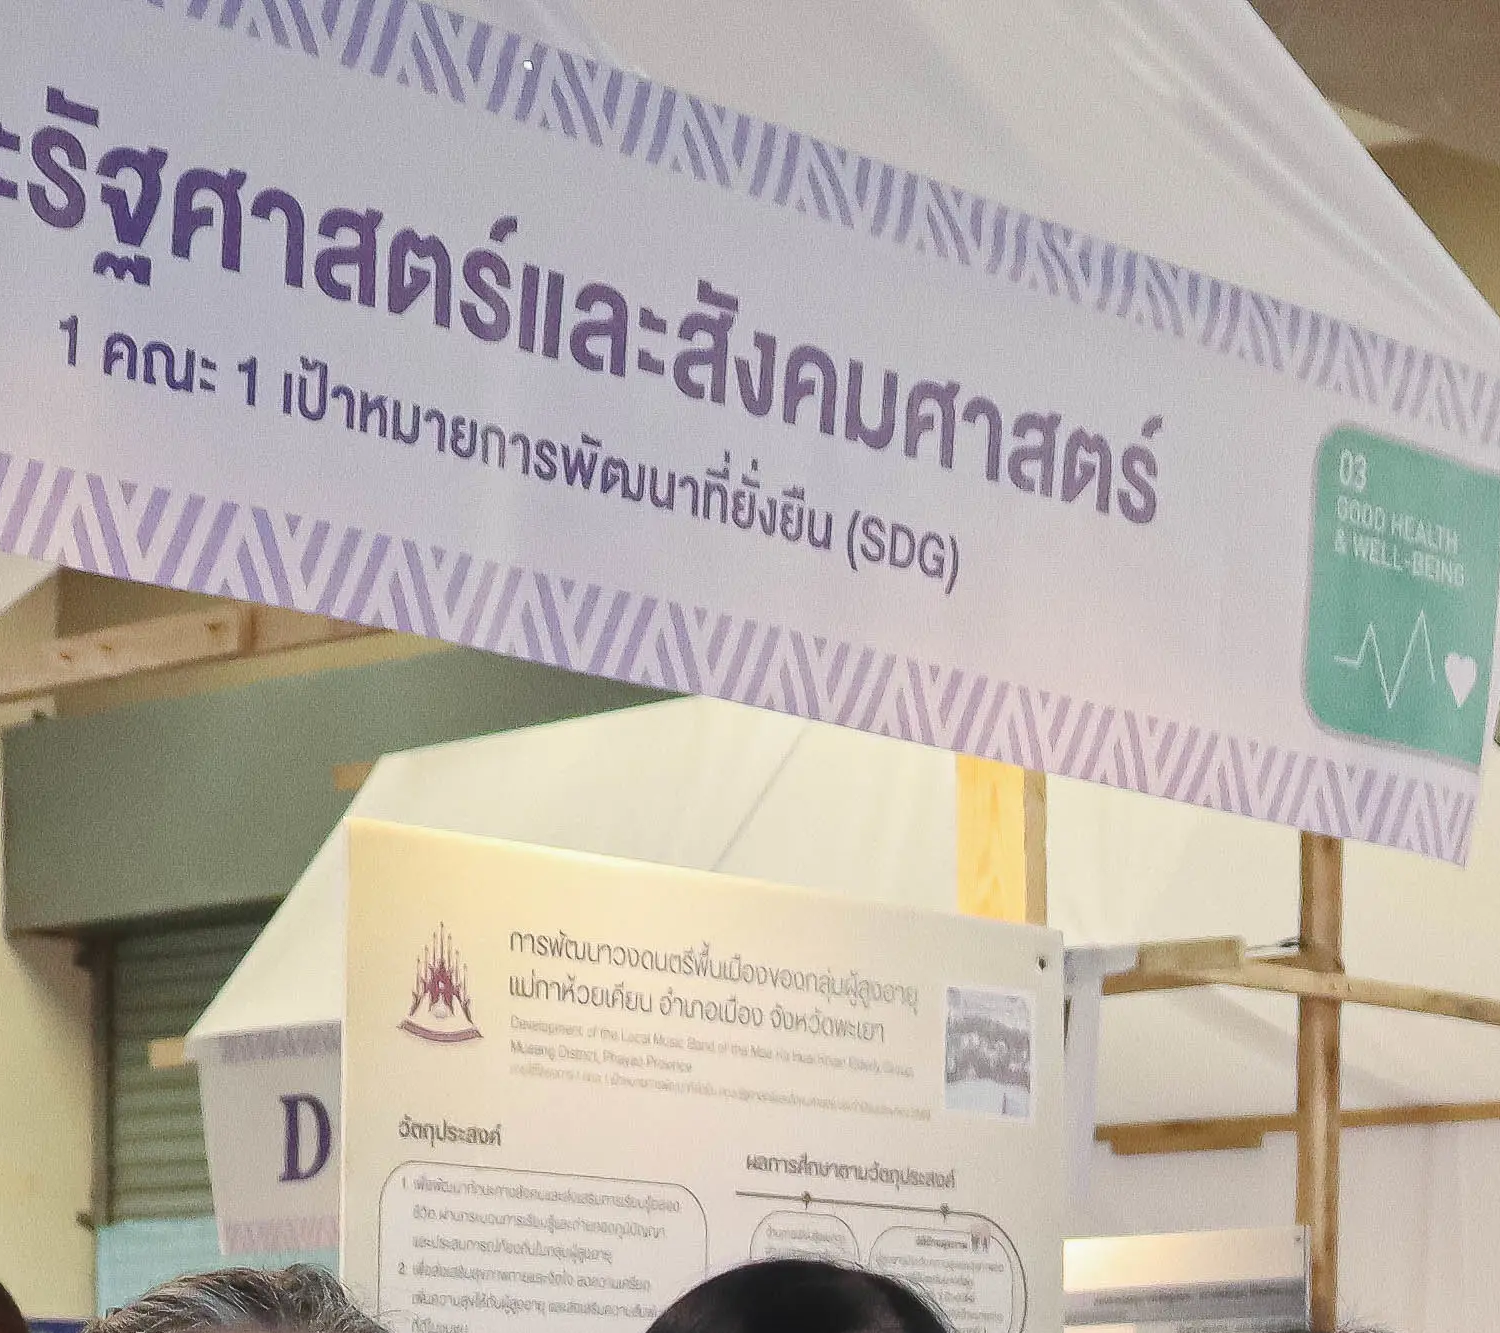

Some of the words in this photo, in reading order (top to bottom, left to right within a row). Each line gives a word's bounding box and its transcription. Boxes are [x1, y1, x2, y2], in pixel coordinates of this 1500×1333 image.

[59, 316, 77, 367] 1
[103, 331, 217, 393] คณะ
[237, 359, 256, 407] 1
[282, 358, 833, 554] เป้าหมายการพัฒนาที่ยั่งยืน
[846, 510, 961, 593] (SDG)
[1338, 447, 1368, 493] 03
[1336, 495, 1386, 532] GOOD
[1390, 512, 1460, 555] HEALTH
[1333, 527, 1349, 554] &
[1352, 530, 1466, 588] WELL-BEING
[509, 929, 919, 1016] การพัฒนาวงดนตรีพื้นเมืองของกลุ่มผู้สูงอายุ
[509, 969, 652, 1014] แม่กาห้วยเคียน
[659, 986, 764, 1027] อำเภอเมือง
[770, 1001, 886, 1043] จังหวัดพะเยา
[279, 1093, 333, 1183] D
[398, 1113, 503, 1149] วัตถุประสงค์
[746, 1151, 957, 1192] ผลการศึกษาตามวัตถุประสงค์
